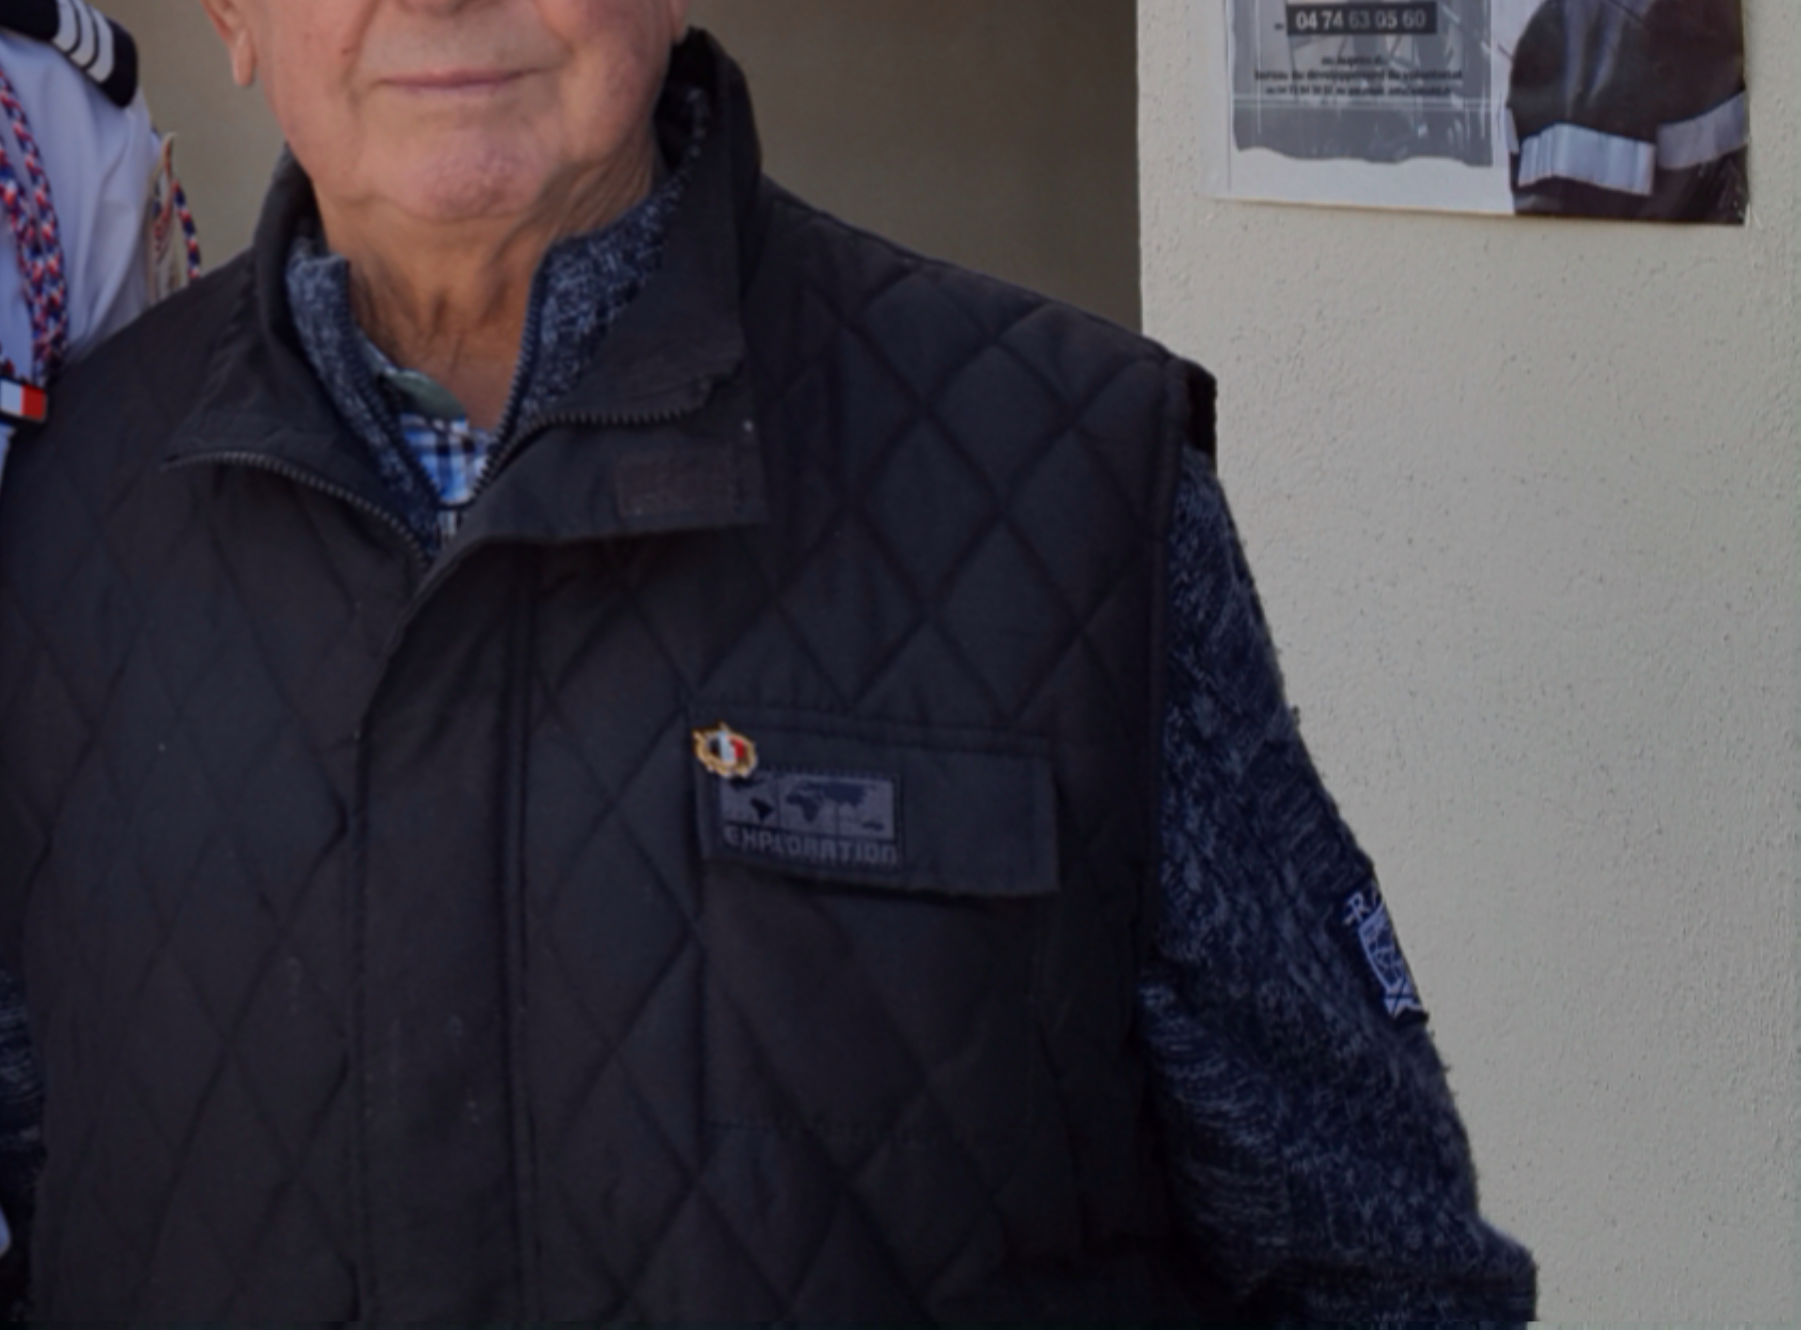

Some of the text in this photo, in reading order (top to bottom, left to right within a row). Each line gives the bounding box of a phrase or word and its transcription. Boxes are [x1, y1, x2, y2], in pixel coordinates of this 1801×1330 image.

[1296, 11, 1317, 30] 04
[1321, 10, 1344, 29] 74
[723, 825, 897, 866] EXPLORATION
